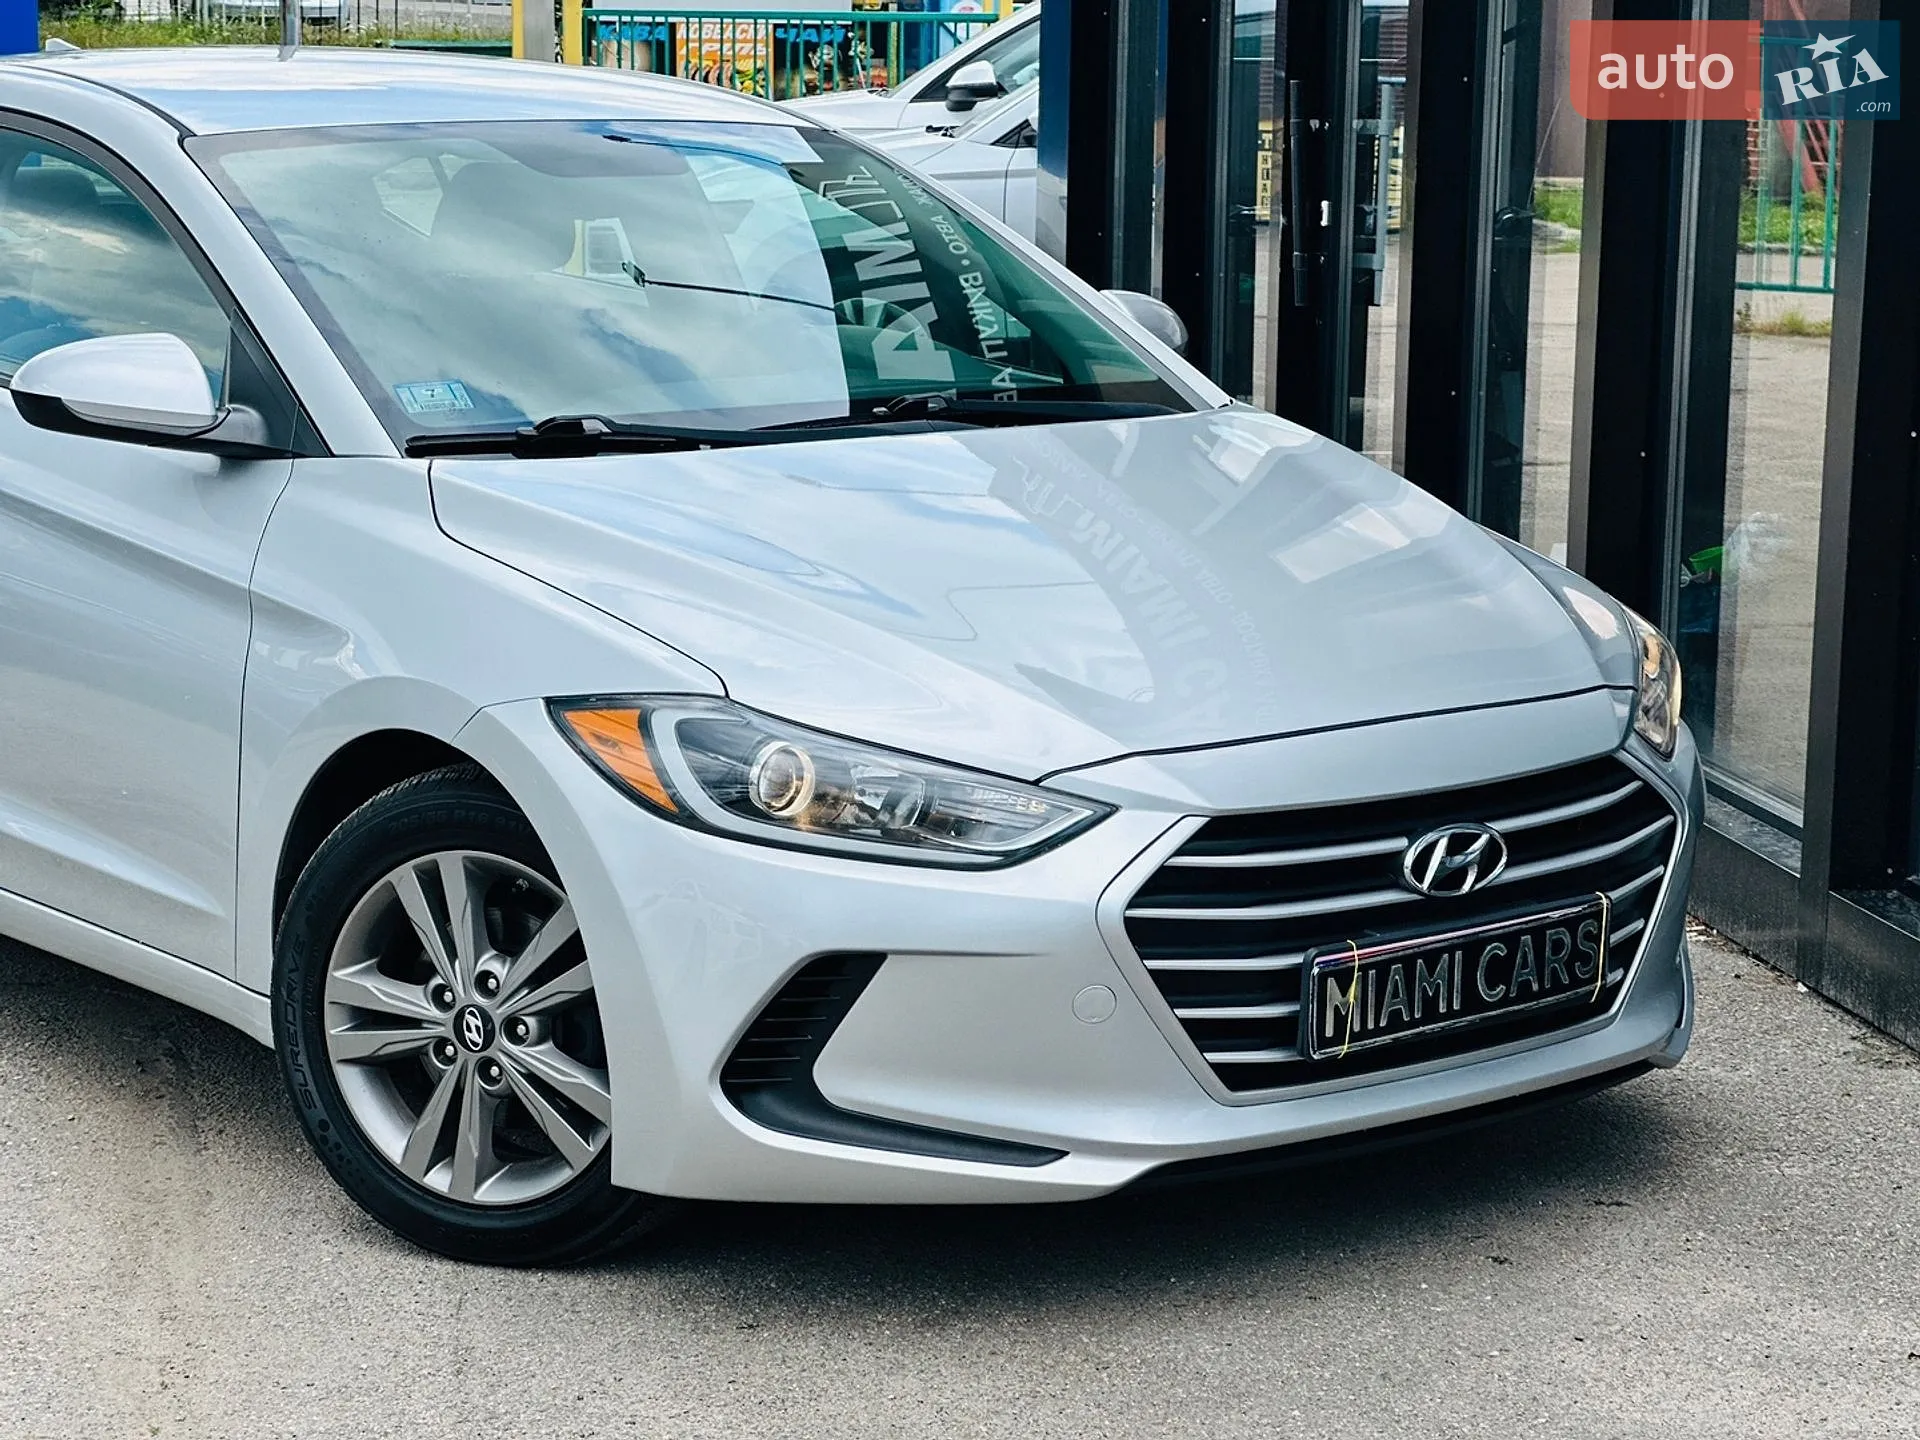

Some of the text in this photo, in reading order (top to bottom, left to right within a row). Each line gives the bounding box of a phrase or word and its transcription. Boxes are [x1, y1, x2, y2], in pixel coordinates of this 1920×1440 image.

[284, 937, 318, 1111] SUREDRIVE
[1325, 918, 1599, 1038] MIAMI CARS
